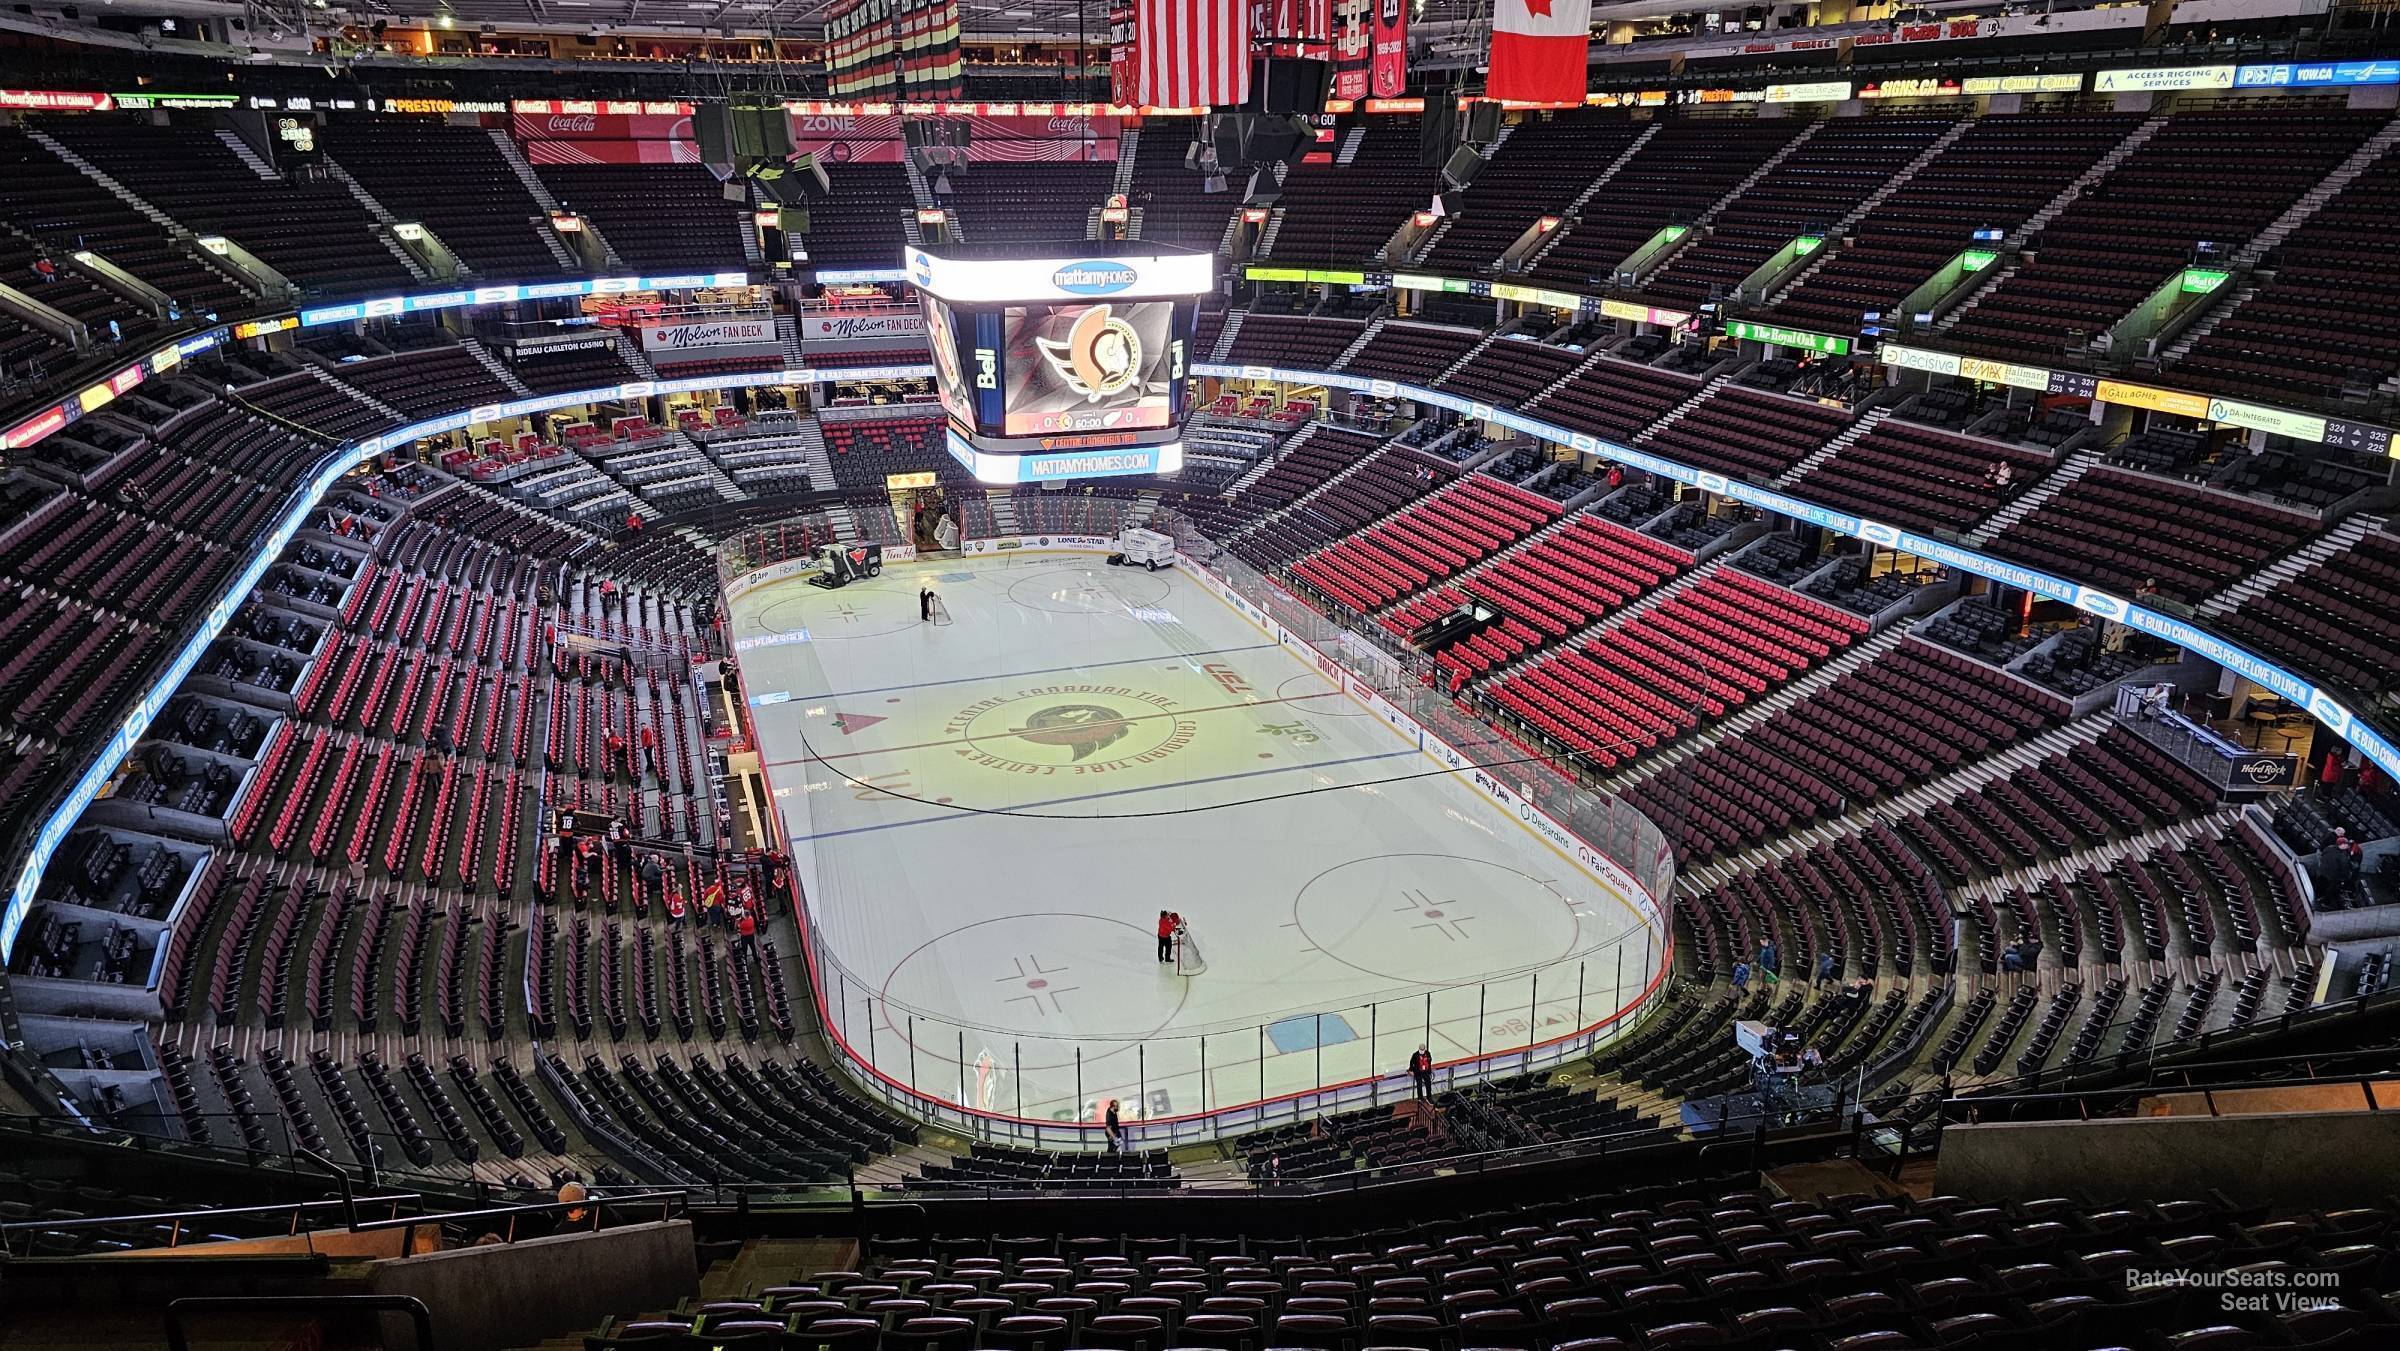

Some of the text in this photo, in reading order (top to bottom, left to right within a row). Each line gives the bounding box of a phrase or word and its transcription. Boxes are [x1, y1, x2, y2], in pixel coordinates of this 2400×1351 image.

[1111, 24, 1124, 44] 2007
[1347, 0, 1361, 56] 8
[2166, 70, 2212, 78] RIGGING
[2297, 69, 2333, 81] YOW.CA
[1880, 79, 1938, 97] SIGNS.CA
[2143, 79, 2191, 88] SERVICES
[1702, 90, 1734, 101] PRESTON
[397, 99, 506, 113] PRESTON HARDWARE
[278, 118, 298, 129] GO
[549, 115, 595, 132] Coca-Cola
[803, 117, 857, 131] ZONE
[1048, 117, 1091, 132] Coca-Cola
[281, 129, 313, 141] SENS
[294, 140, 314, 151] GO
[834, 319, 925, 337] Molson FAN DECK
[669, 325, 763, 346] Molson FAN DECK
[1753, 326, 1817, 347] The Royal Oak
[516, 340, 604, 356] RIDEAU CARLETON CASINO
[1171, 339, 1184, 380] Bell
[1900, 351, 1954, 373] Decisive
[977, 349, 996, 389] Bell
[2005, 366, 2046, 380] Hallmark
[2052, 374, 2065, 382] 323
[2081, 377, 2095, 387] 324
[2079, 389, 2093, 398] 224
[2108, 388, 2158, 401] GALLAGHER
[1044, 417, 1052, 427] 0
[1075, 418, 1101, 429] 60:00
[1126, 412, 1133, 422] 0
[2230, 408, 2282, 425] DA-INTEGRATED
[2329, 423, 2346, 433] 324
[2327, 434, 2343, 444] 224
[2369, 430, 2387, 441] 325
[2367, 442, 2385, 453] 225
[1032, 454, 1149, 475] MATTAMYHOMES.COM
[1903, 538, 2071, 599] WE BUILD COMMUNITIES PEOPLE LOVE TO LIVE IN
[2132, 610, 2306, 700] WE BUILD COMMUNITIES PEOPLE LOVE TO LIVE IN
[1317, 655, 1340, 682] BRICK
[1018, 685, 1131, 697] CANADIAN
[1140, 691, 1179, 708] TIRE
[2351, 724, 2379, 757] WE BUILD
[1446, 750, 1460, 769] Bell
[1076, 763, 1133, 775] TIRE
[2241, 762, 2287, 775] Hard Rock
[1531, 812, 1570, 849] Desjardins
[1591, 855, 1633, 896] FairSquare
